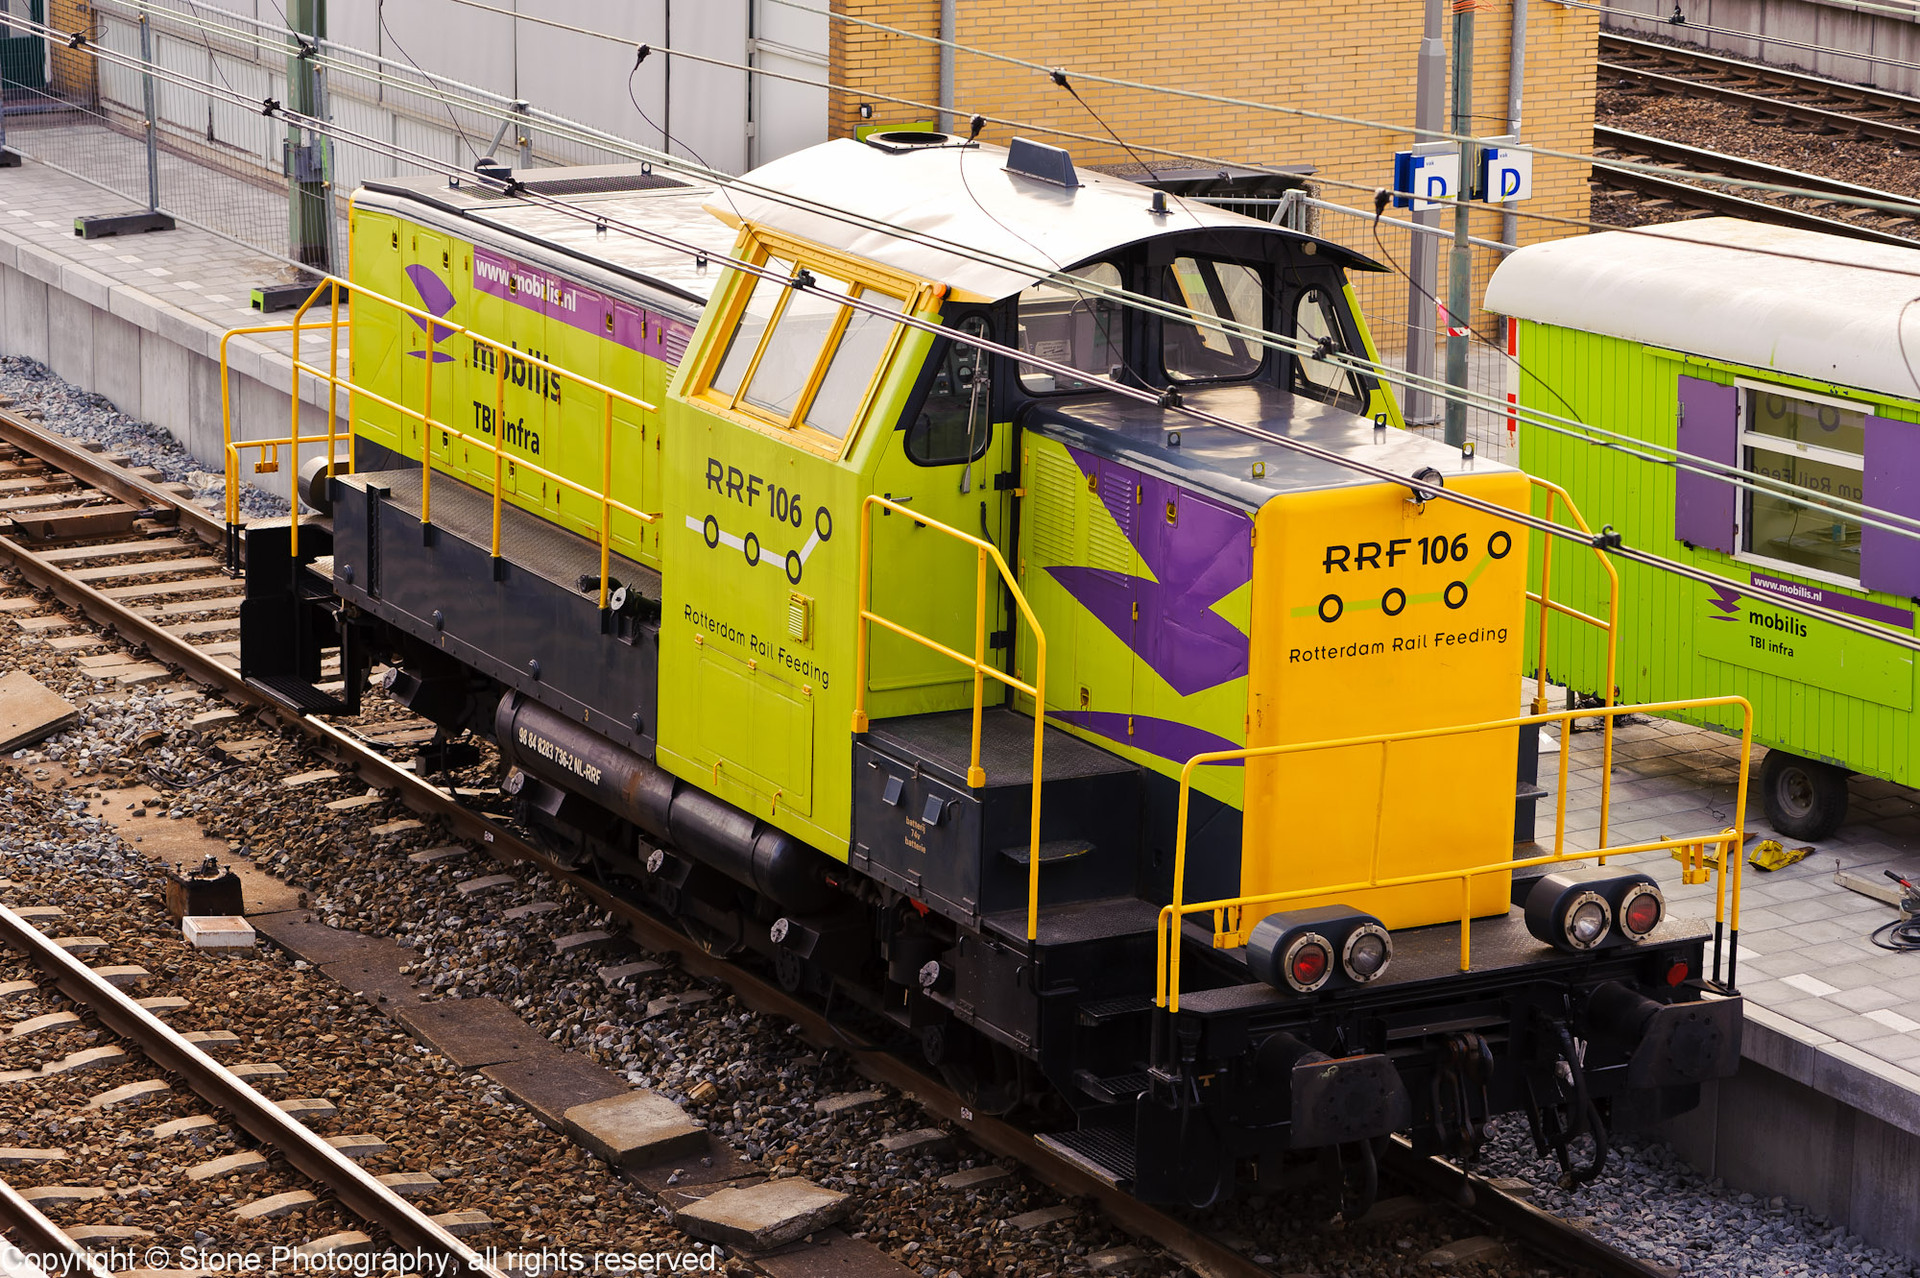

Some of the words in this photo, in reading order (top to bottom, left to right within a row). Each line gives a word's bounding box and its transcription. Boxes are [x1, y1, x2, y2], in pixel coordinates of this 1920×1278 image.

[1427, 176, 1447, 205] D
[1501, 168, 1521, 196] D
[473, 400, 496, 436] TBI
[502, 411, 540, 455] infra
[705, 457, 764, 506] RRF
[767, 483, 803, 528] 106
[1323, 538, 1412, 574] RRF
[1417, 533, 1469, 565] 106
[1753, 577, 1822, 602] www.mobilis.nl
[1749, 611, 1807, 638] mobilis
[684, 604, 746, 646] Rotterdam
[750, 634, 774, 660] Rail
[778, 647, 830, 690] Feeding
[1289, 641, 1385, 663] Rotterdam
[1392, 634, 1428, 652] Rail
[1434, 627, 1508, 647] Feeding
[1749, 635, 1766, 650] TBI
[1768, 639, 1794, 657] infra
[518, 727, 528, 745] 98
[528, 732, 537, 751] 84
[537, 737, 554, 760] 8283
[554, 746, 574, 771] 736-2
[573, 757, 602, 786] NL-RRF
